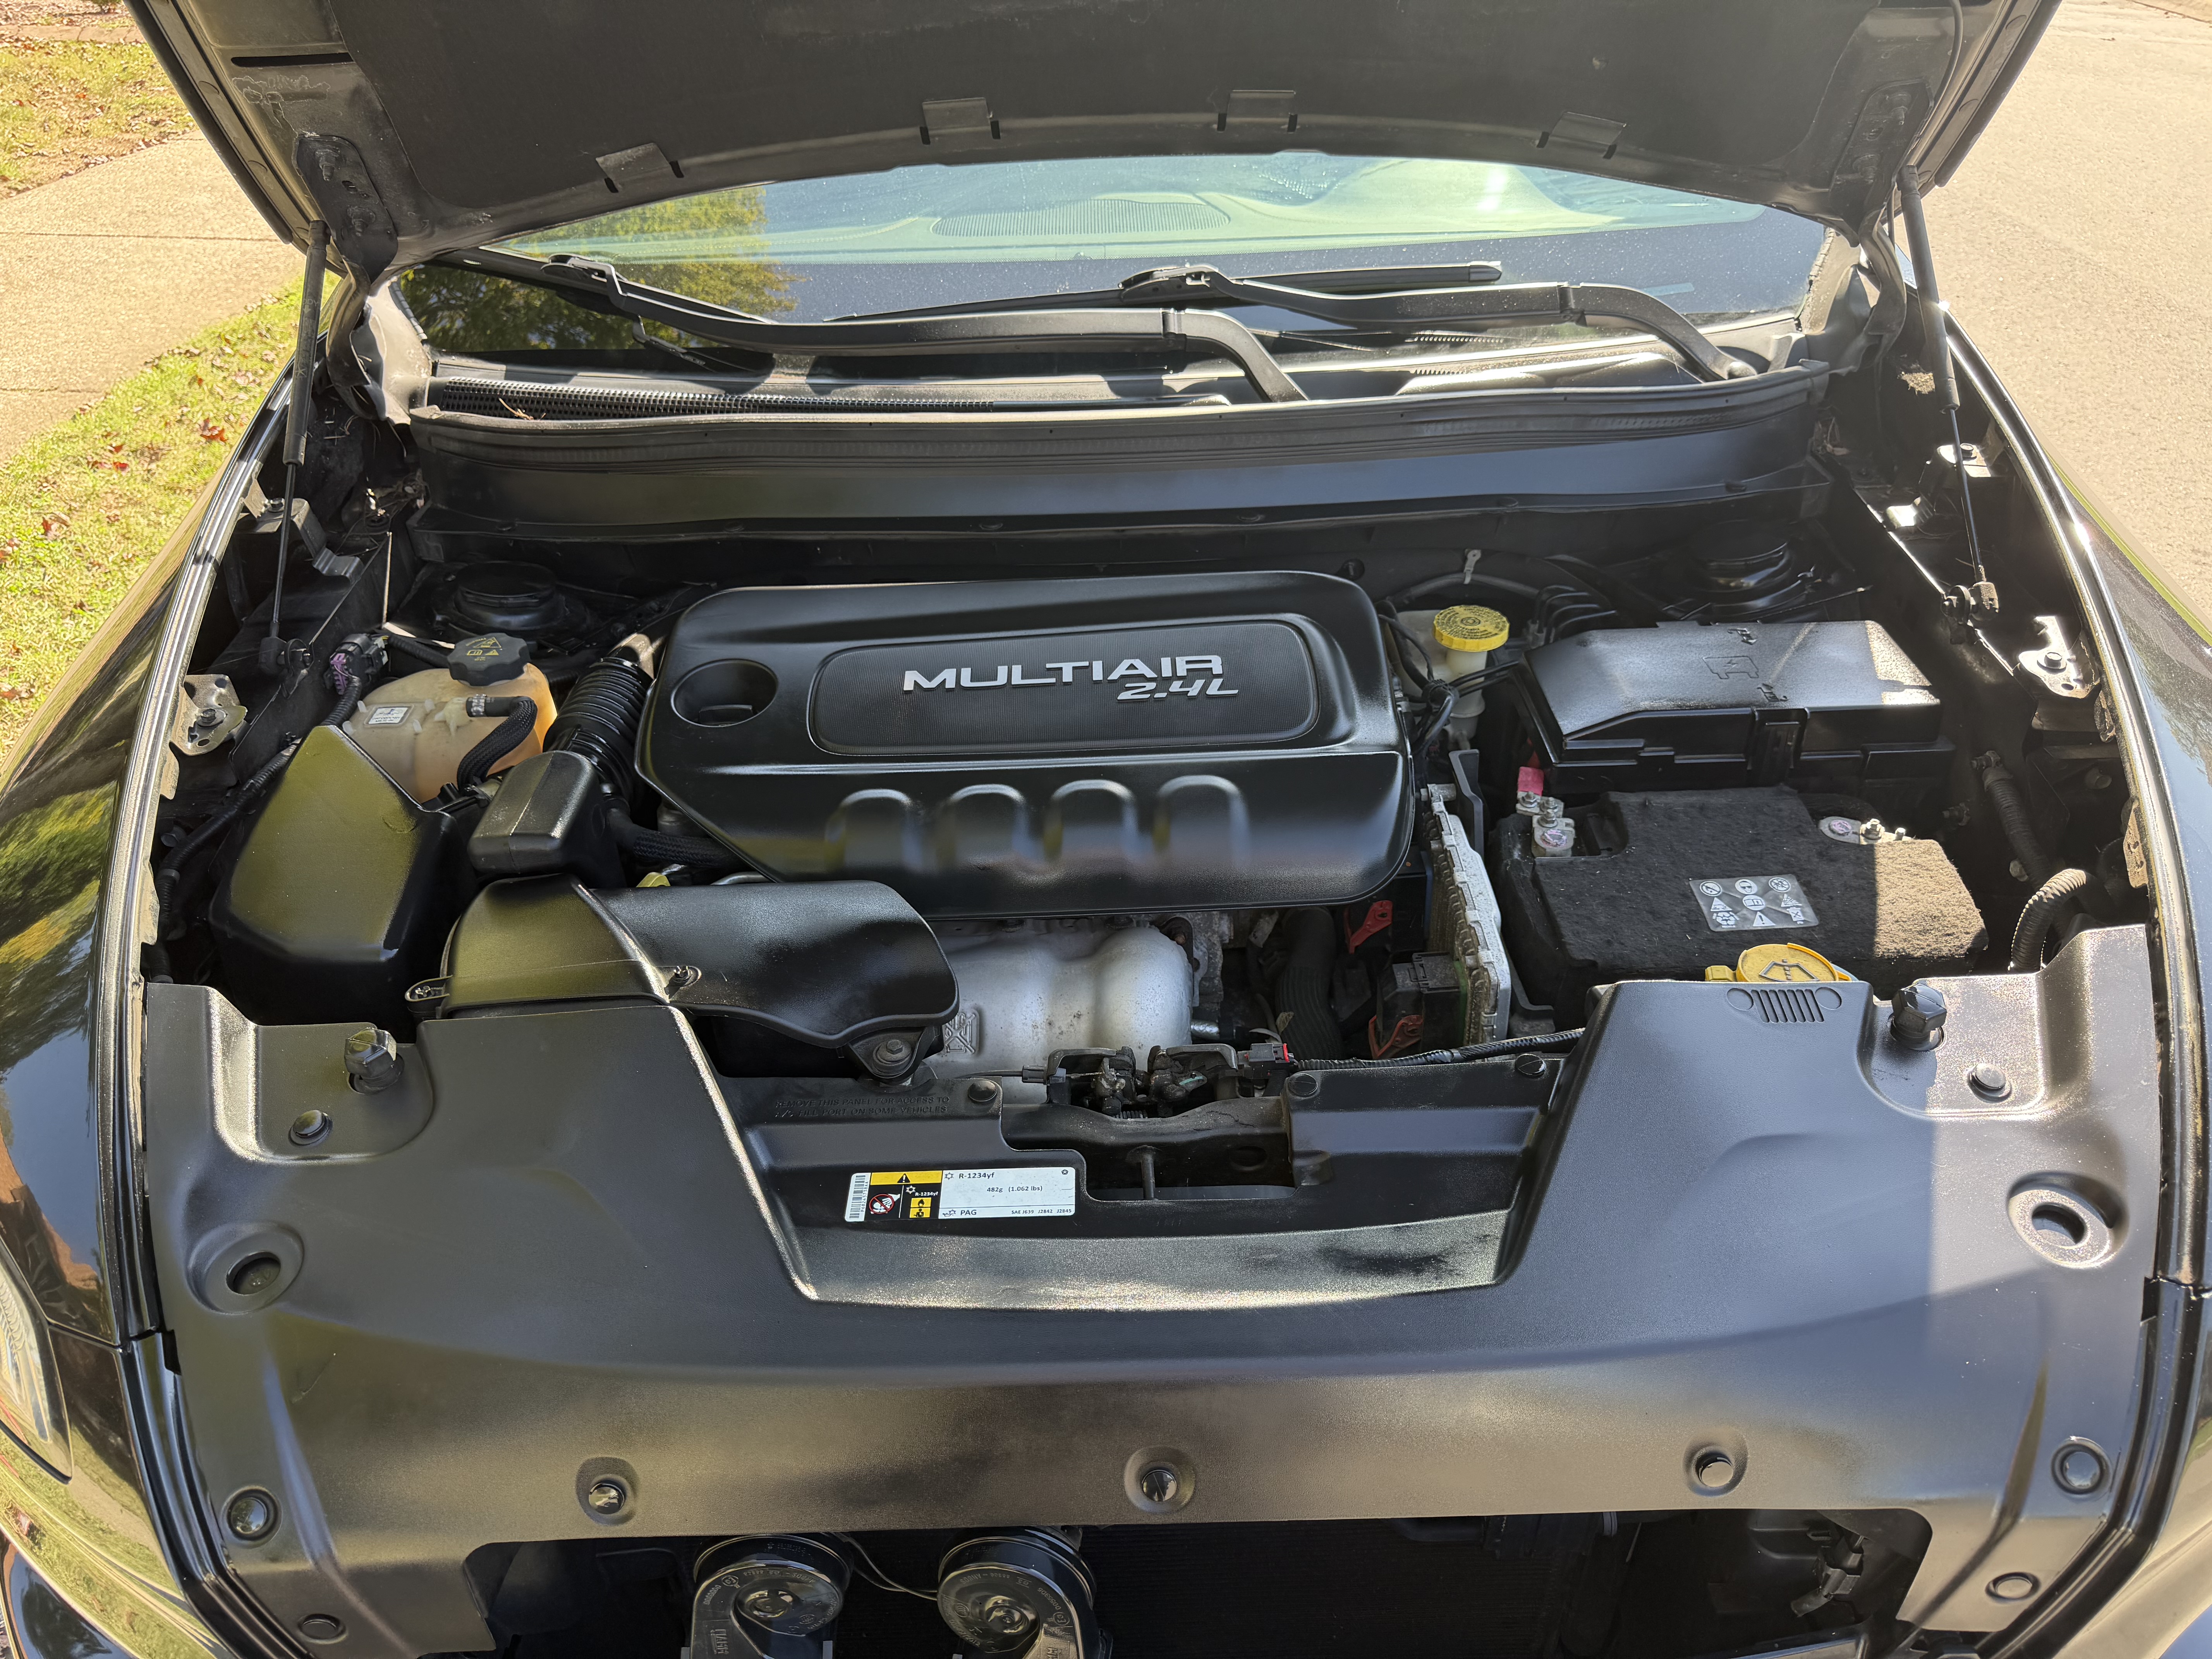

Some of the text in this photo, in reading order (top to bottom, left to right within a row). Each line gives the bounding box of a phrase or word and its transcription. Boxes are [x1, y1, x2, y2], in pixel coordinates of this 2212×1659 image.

[903, 655, 1223, 692] MULTIAIR
[1116, 678, 1239, 701] 2.4L
[775, 1100, 816, 1108] REMOVE
[799, 1109, 819, 1117] FILL
[822, 1108, 845, 1116] PORT
[868, 1106, 897, 1115] SOME
[900, 1106, 948, 1114] VEHICLES
